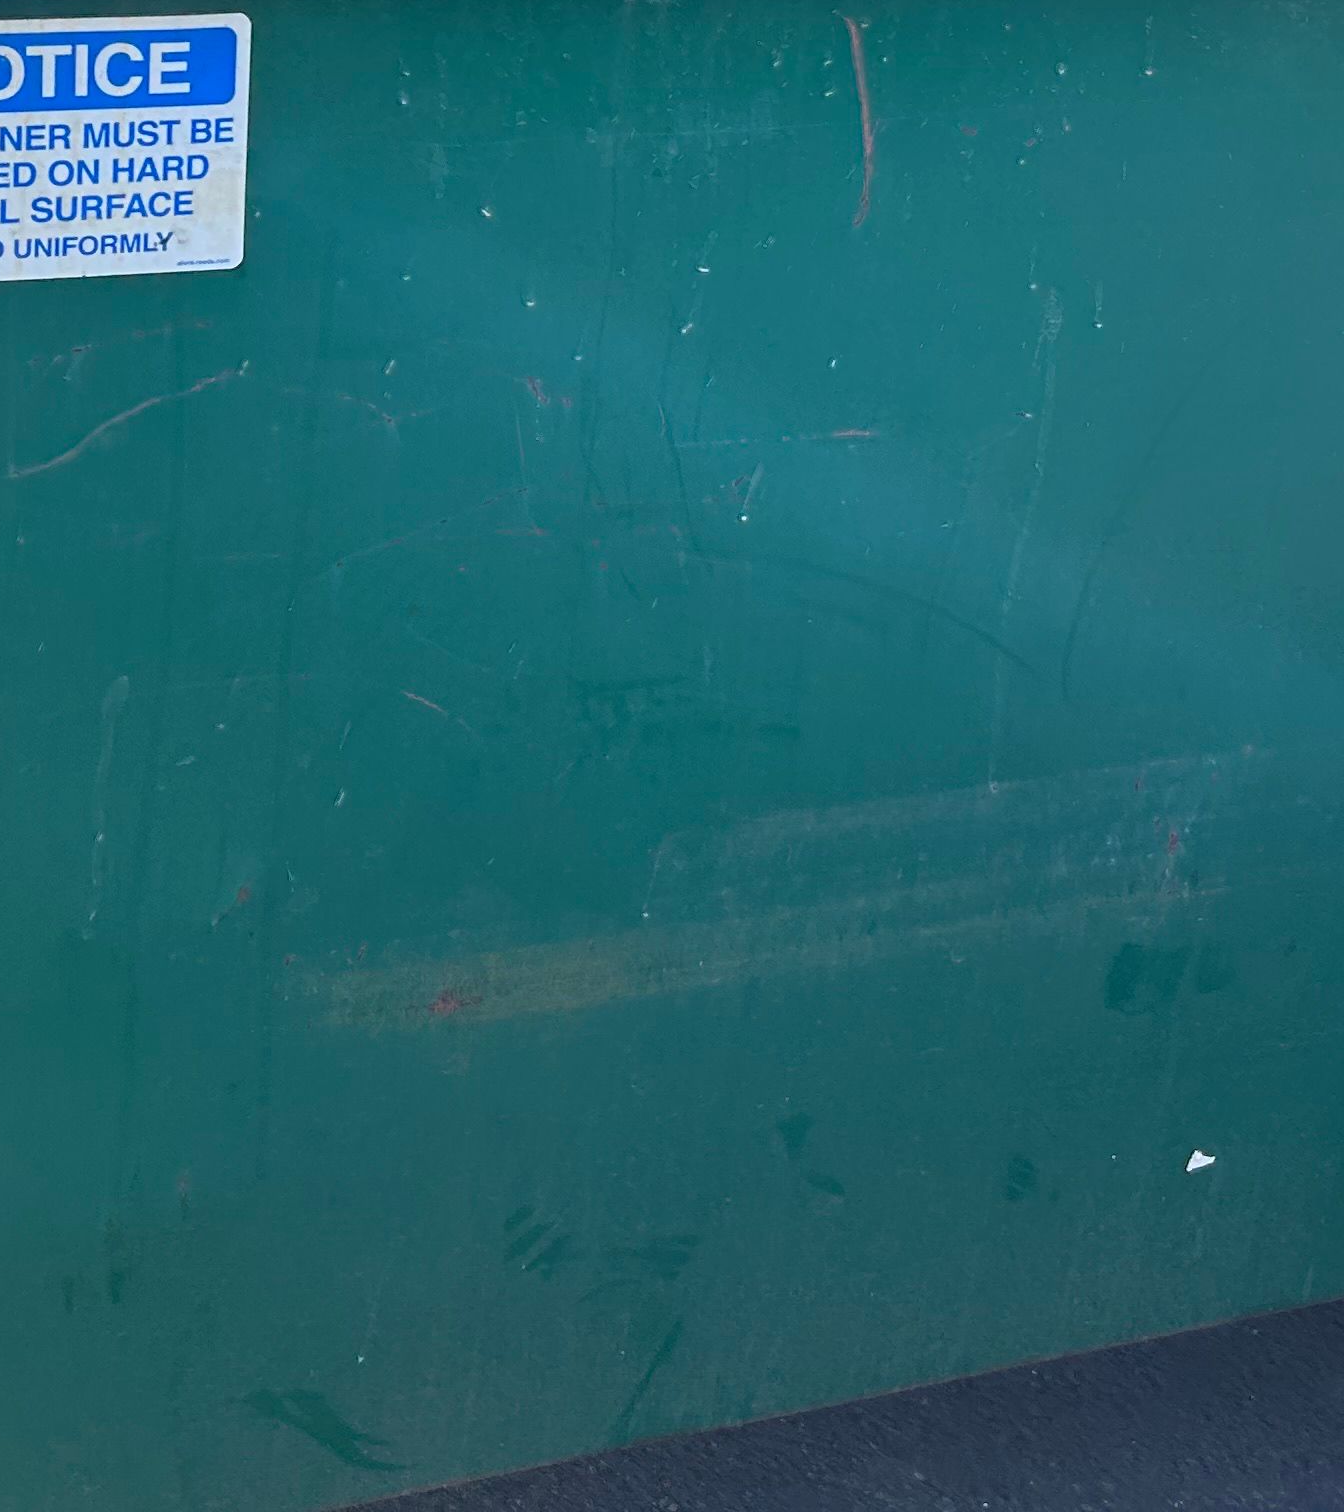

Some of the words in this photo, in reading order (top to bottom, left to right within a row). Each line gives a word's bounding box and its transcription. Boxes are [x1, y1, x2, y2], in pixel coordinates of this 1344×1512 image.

[82, 120, 181, 149] MUST
[190, 118, 234, 144] BE
[48, 159, 99, 186] ON
[112, 155, 209, 184] HARD
[31, 191, 193, 223] SURFACE
[14, 232, 174, 259] UNIFORMLY
